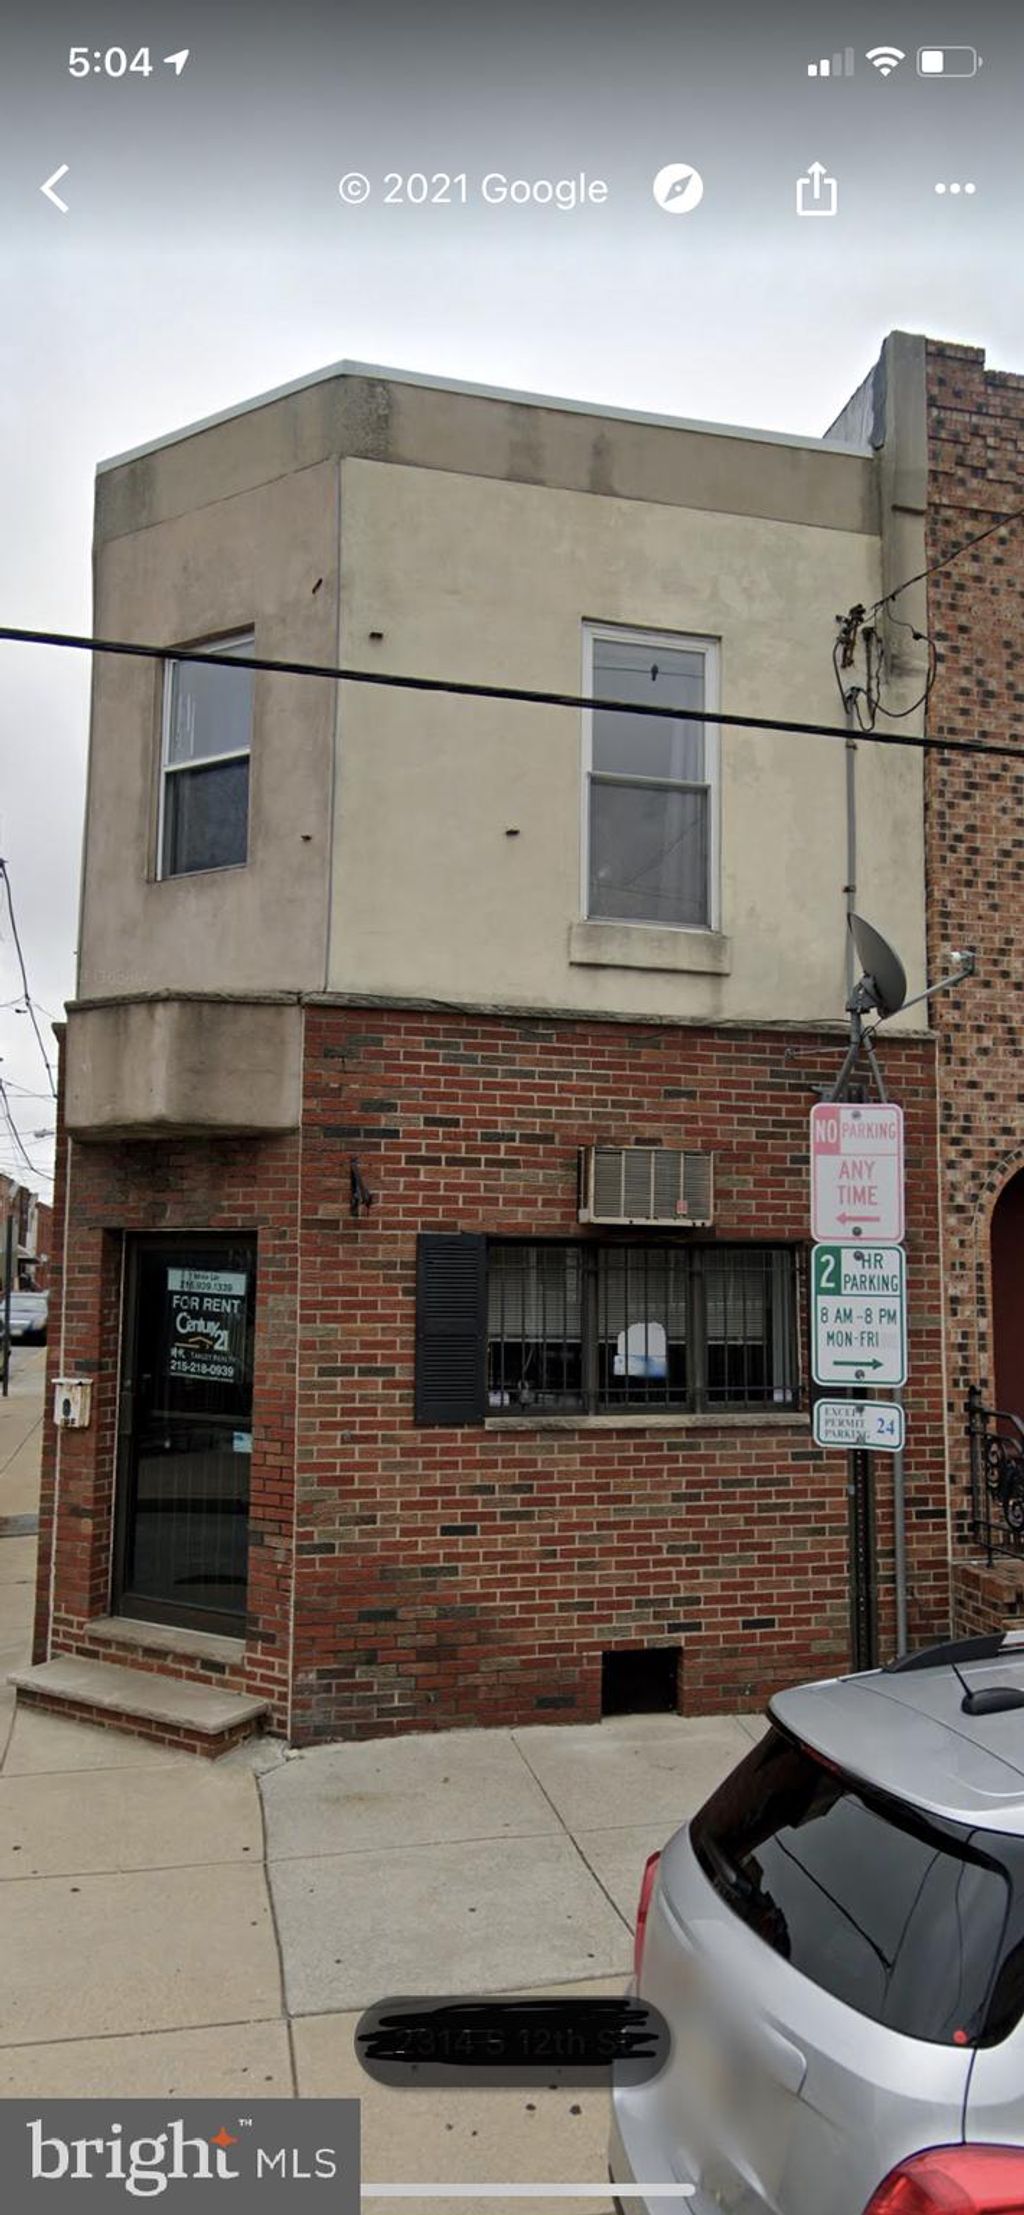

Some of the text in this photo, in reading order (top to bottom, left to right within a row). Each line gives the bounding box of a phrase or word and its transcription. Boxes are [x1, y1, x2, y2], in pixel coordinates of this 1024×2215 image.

[815, 1119, 896, 1143] NO PARKING
[838, 1160, 876, 1180] ANY
[838, 1185, 878, 1206] TIME
[820, 1253, 884, 1288] 2 HR
[843, 1274, 899, 1292] PARKING
[172, 1294, 241, 1313] FOR RENT
[820, 1306, 829, 1324] 8
[834, 1306, 853, 1324] AM
[879, 1308, 897, 1325] PM
[175, 1311, 230, 1351] Century 21
[825, 1330, 880, 1347] MON-FRI
[877, 1417, 896, 1436] 24
